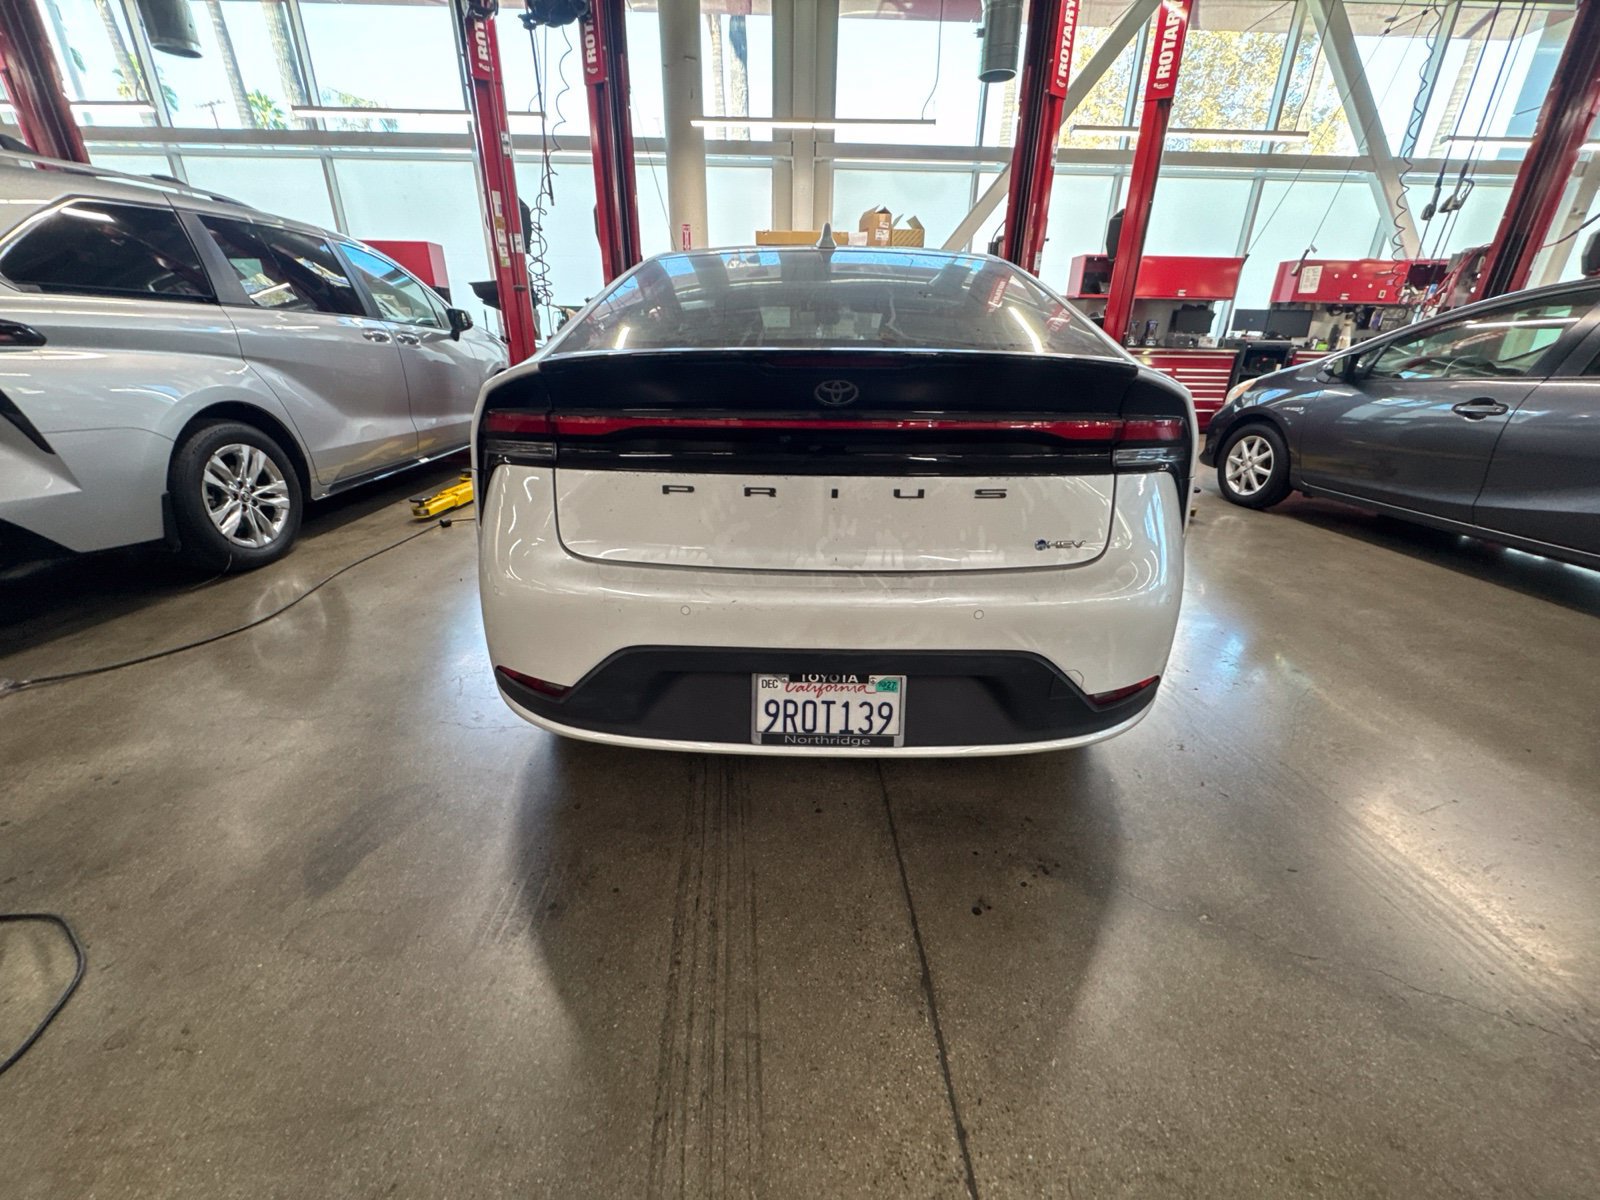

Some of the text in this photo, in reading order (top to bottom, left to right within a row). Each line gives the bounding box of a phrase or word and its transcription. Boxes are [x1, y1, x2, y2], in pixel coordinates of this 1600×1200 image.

[662, 484, 1007, 499] PRIUS
[1050, 539, 1086, 549] HEV
[761, 679, 779, 689] DEC
[801, 673, 859, 683] TOYOTA
[784, 682, 877, 699] California
[763, 699, 894, 735] 9ROT139
[784, 735, 871, 747] Northridge
